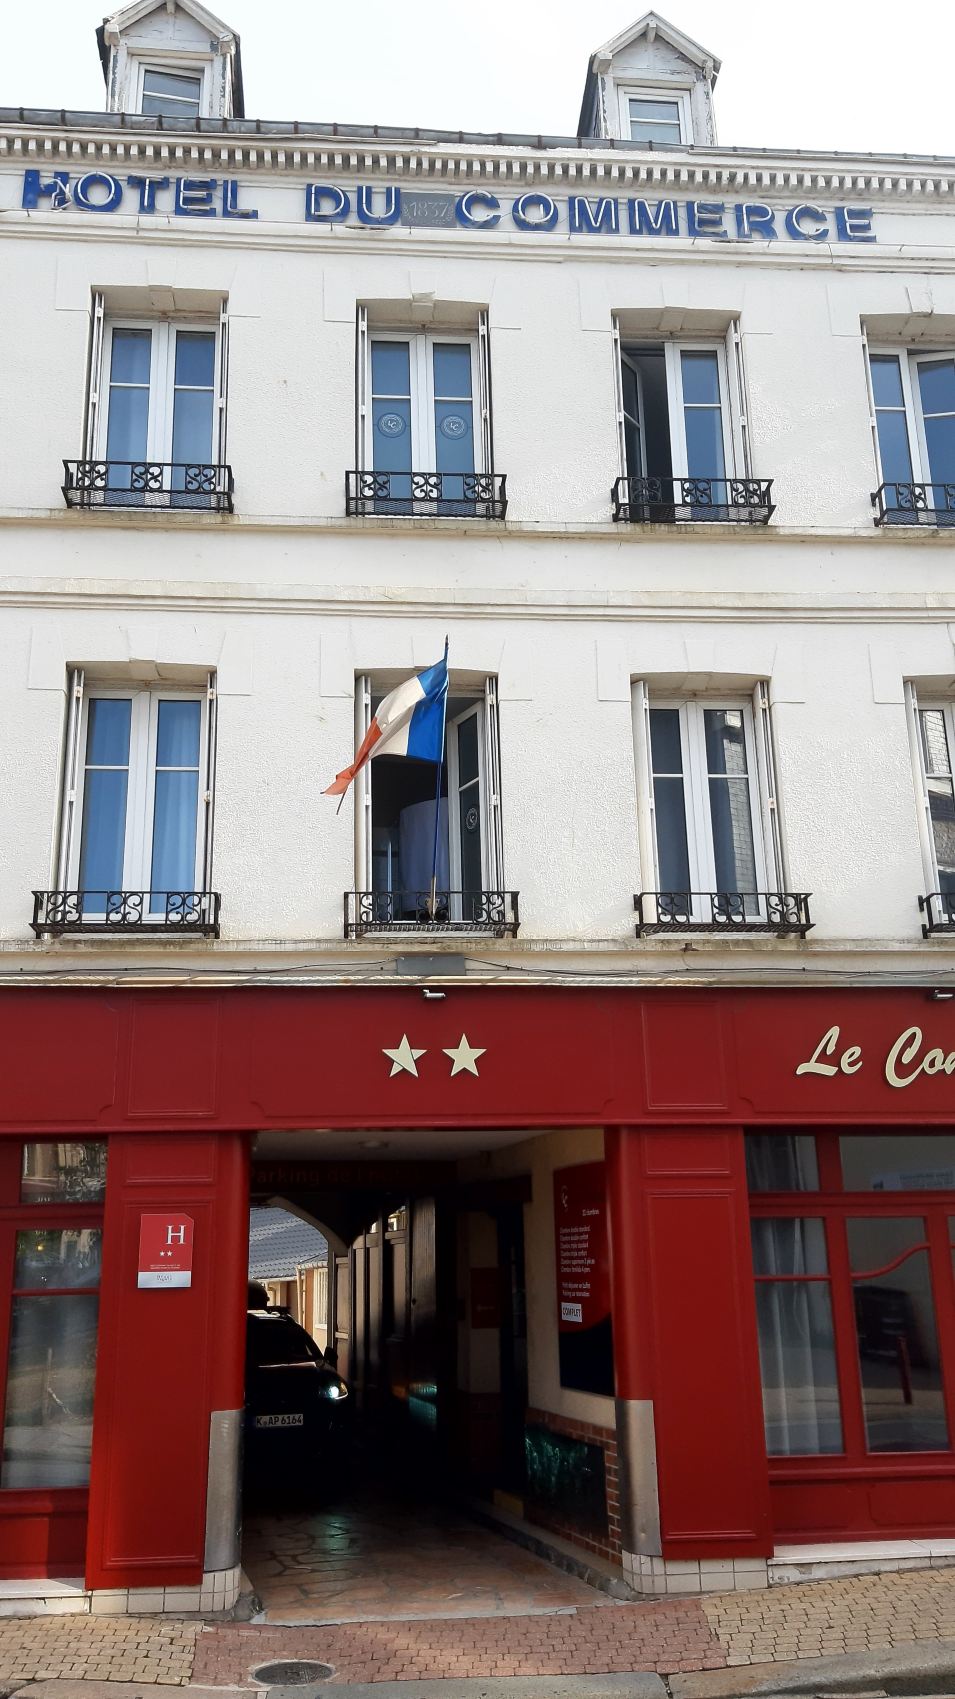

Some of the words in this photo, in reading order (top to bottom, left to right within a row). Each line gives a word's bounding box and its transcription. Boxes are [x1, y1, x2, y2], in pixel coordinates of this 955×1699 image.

[22, 170, 258, 219] HOTEL
[305, 183, 401, 226] DU
[455, 190, 877, 243] COMMERCE
[409, 201, 449, 217] 1837
[796, 1025, 863, 1076] Le
[166, 1224, 186, 1245] H
[562, 1306, 581, 1318] COMPLET
